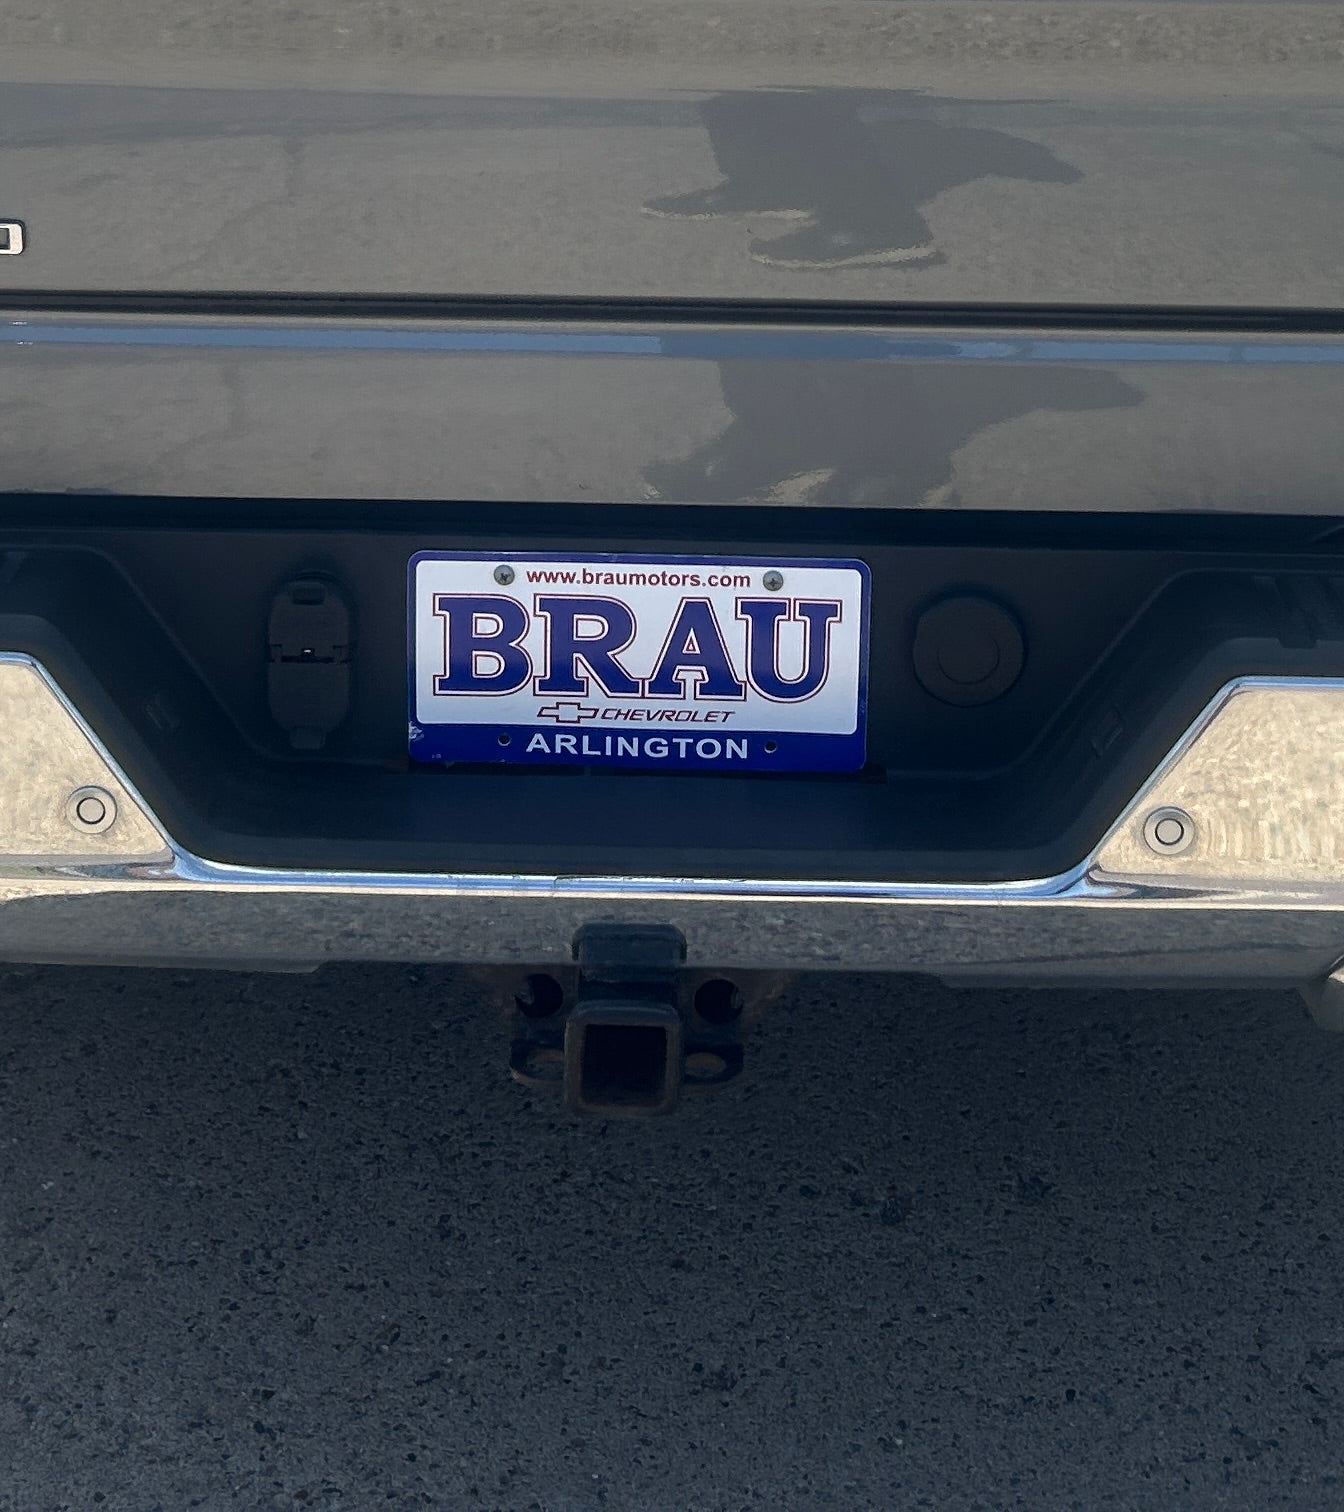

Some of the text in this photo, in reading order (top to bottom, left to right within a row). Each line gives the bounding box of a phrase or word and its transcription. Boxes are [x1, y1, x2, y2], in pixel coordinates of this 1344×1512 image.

[525, 567, 752, 589] www.braumotors.com
[432, 593, 843, 704] BRAU
[600, 706, 736, 724] CHEVROLET
[524, 732, 749, 760] ARLINGTON
